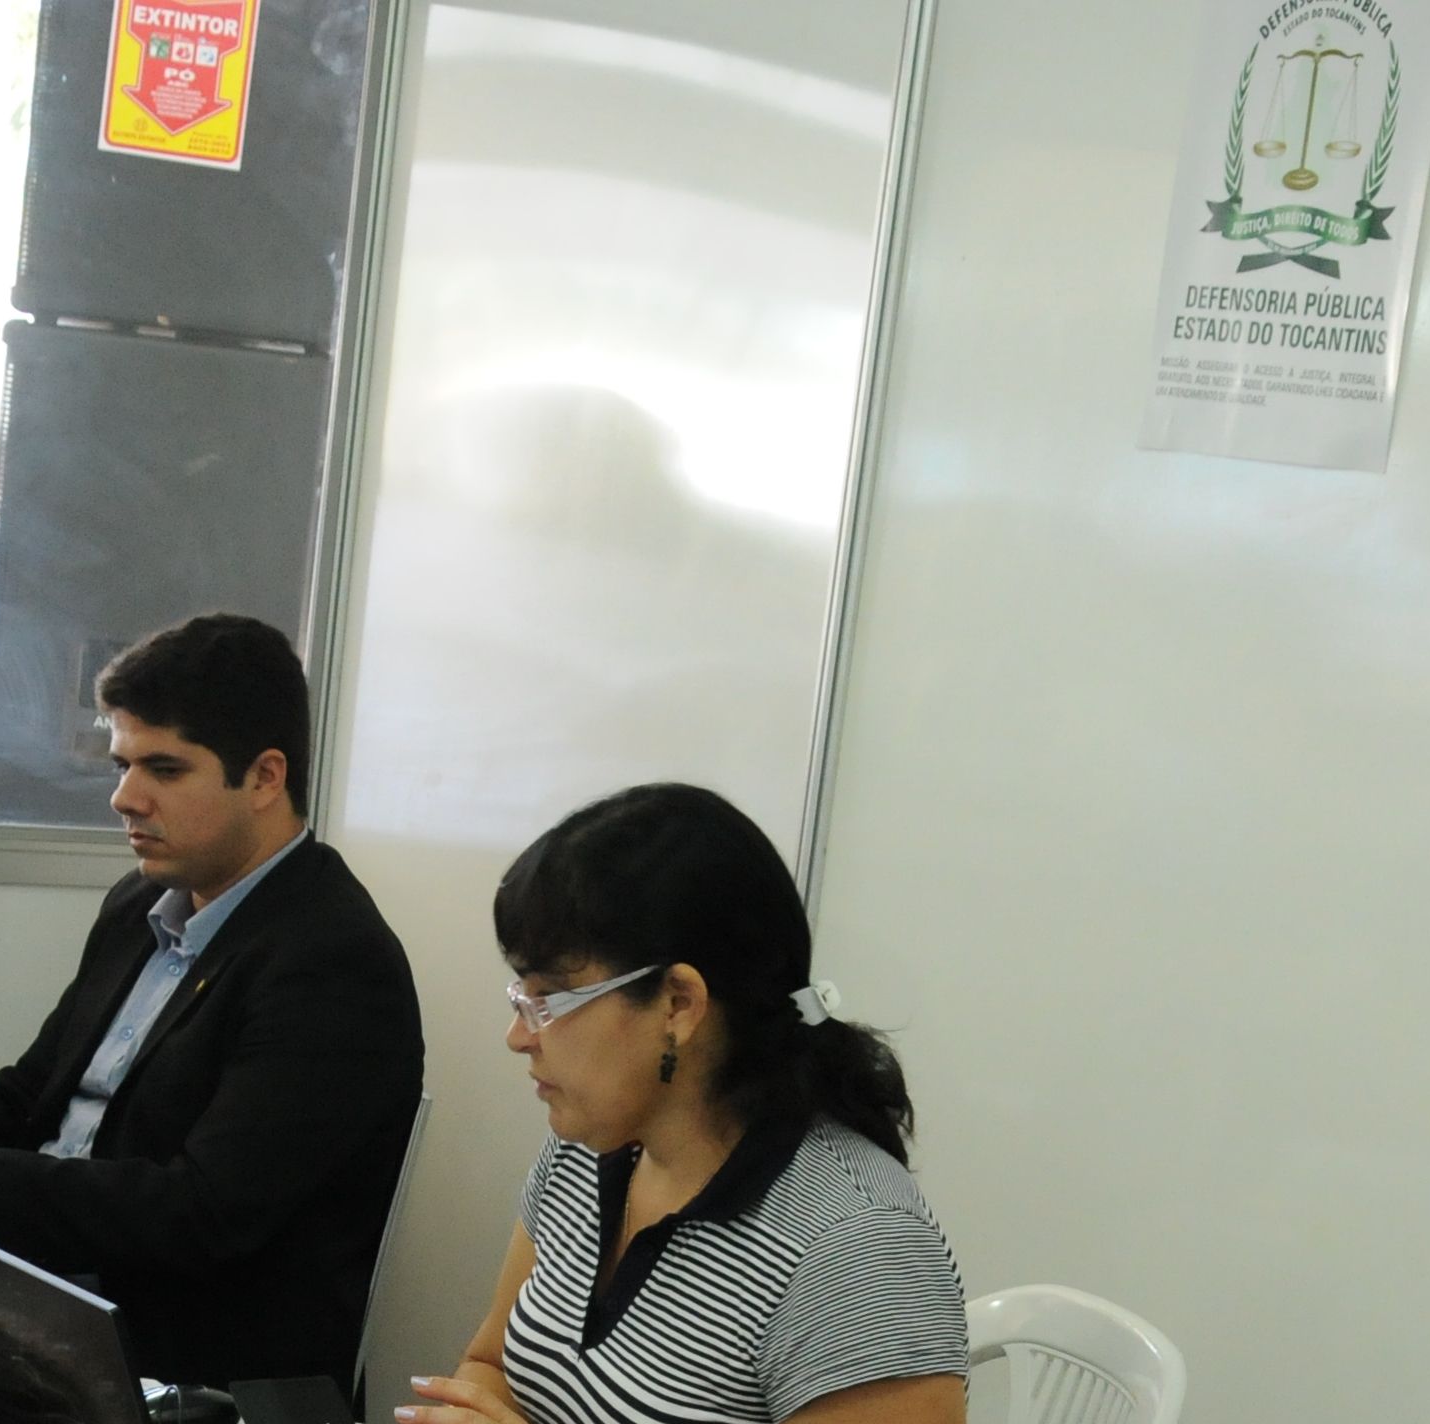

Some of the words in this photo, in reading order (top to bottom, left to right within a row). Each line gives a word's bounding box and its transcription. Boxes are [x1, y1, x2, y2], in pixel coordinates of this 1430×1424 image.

[133, 5, 239, 37] EXTINTOR
[1259, 0, 1337, 39] DEFENS
[1283, 12, 1309, 37] ESTADO
[1311, 8, 1322, 19] DO
[1325, 7, 1367, 35] TOCANTINS
[1274, 211, 1312, 227] DIREITO
[1314, 216, 1326, 231] DE
[1185, 285, 1297, 315] DEFENSORIA
[1304, 286, 1386, 321] PÚBLICA
[1173, 316, 1242, 343] ESTADO
[1247, 321, 1272, 346] DO
[1280, 323, 1388, 356] TOCANTINS
